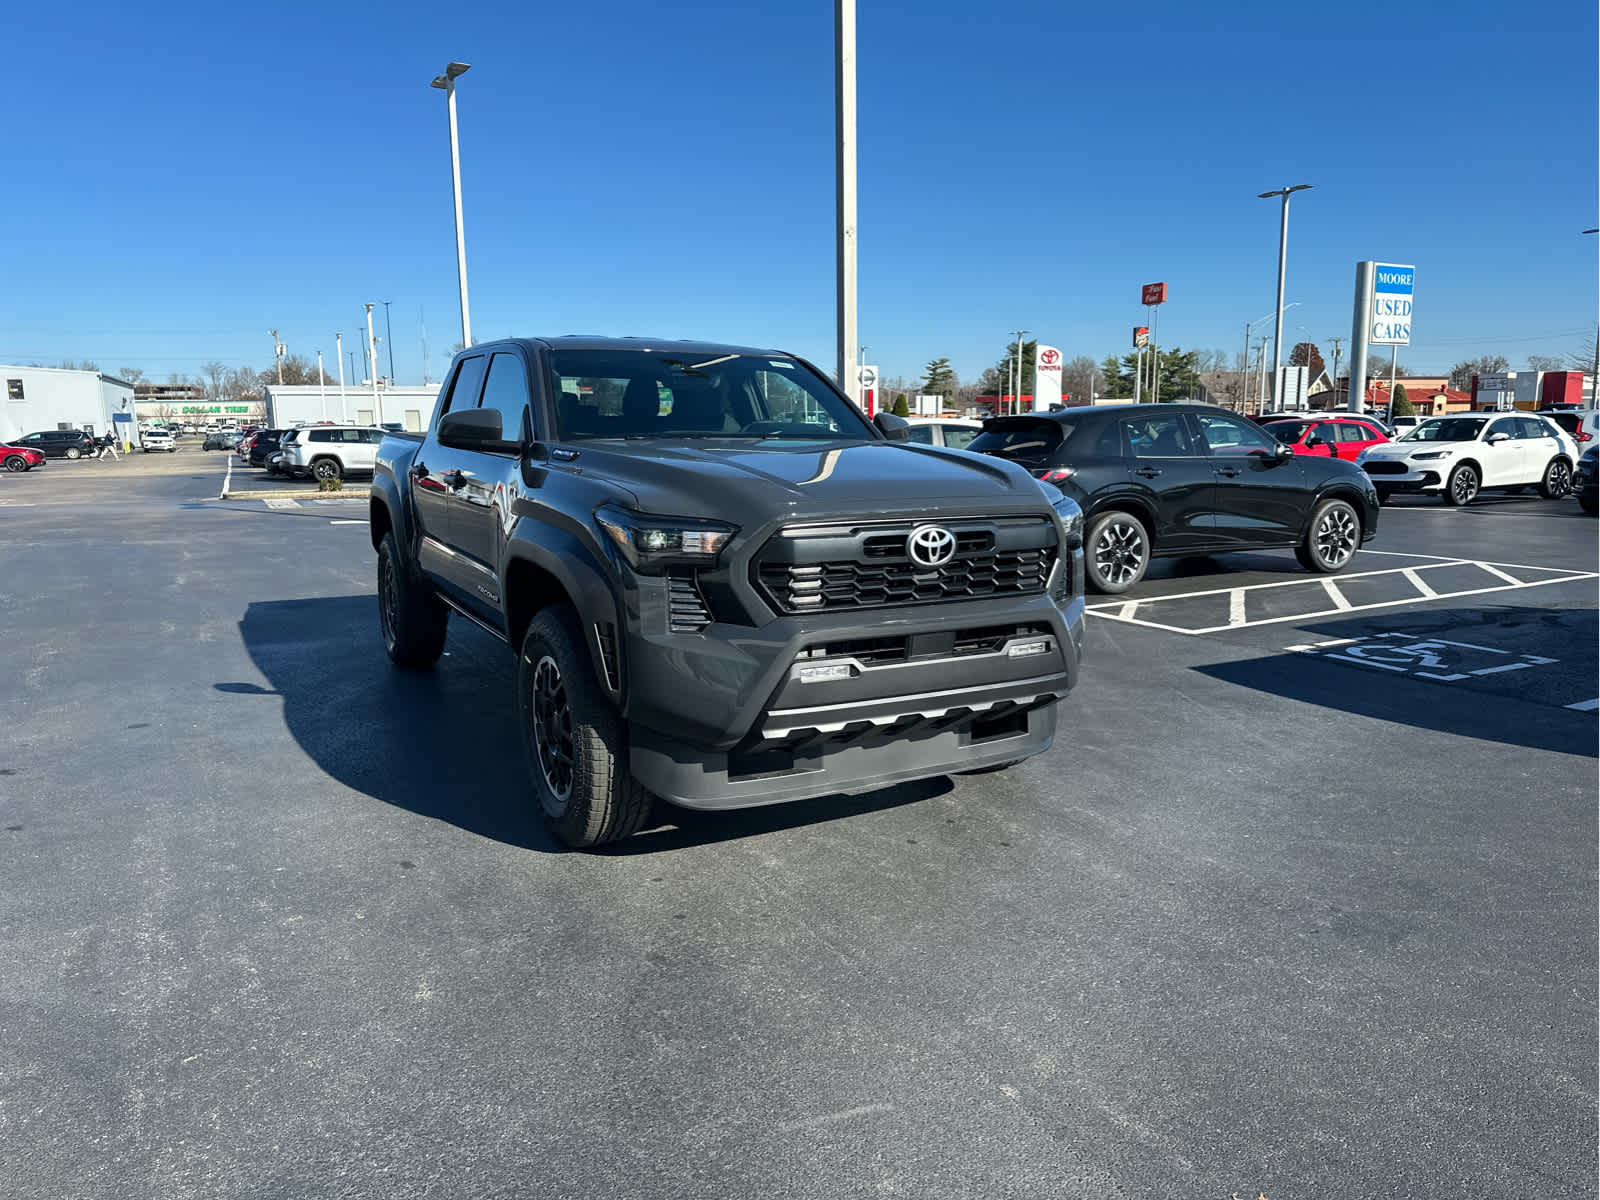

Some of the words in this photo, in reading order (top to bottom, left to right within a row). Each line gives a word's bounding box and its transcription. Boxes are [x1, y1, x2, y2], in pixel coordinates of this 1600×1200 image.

[1378, 272, 1412, 286] MOORE
[1375, 299, 1411, 316] USED
[1373, 322, 1410, 340] CARS
